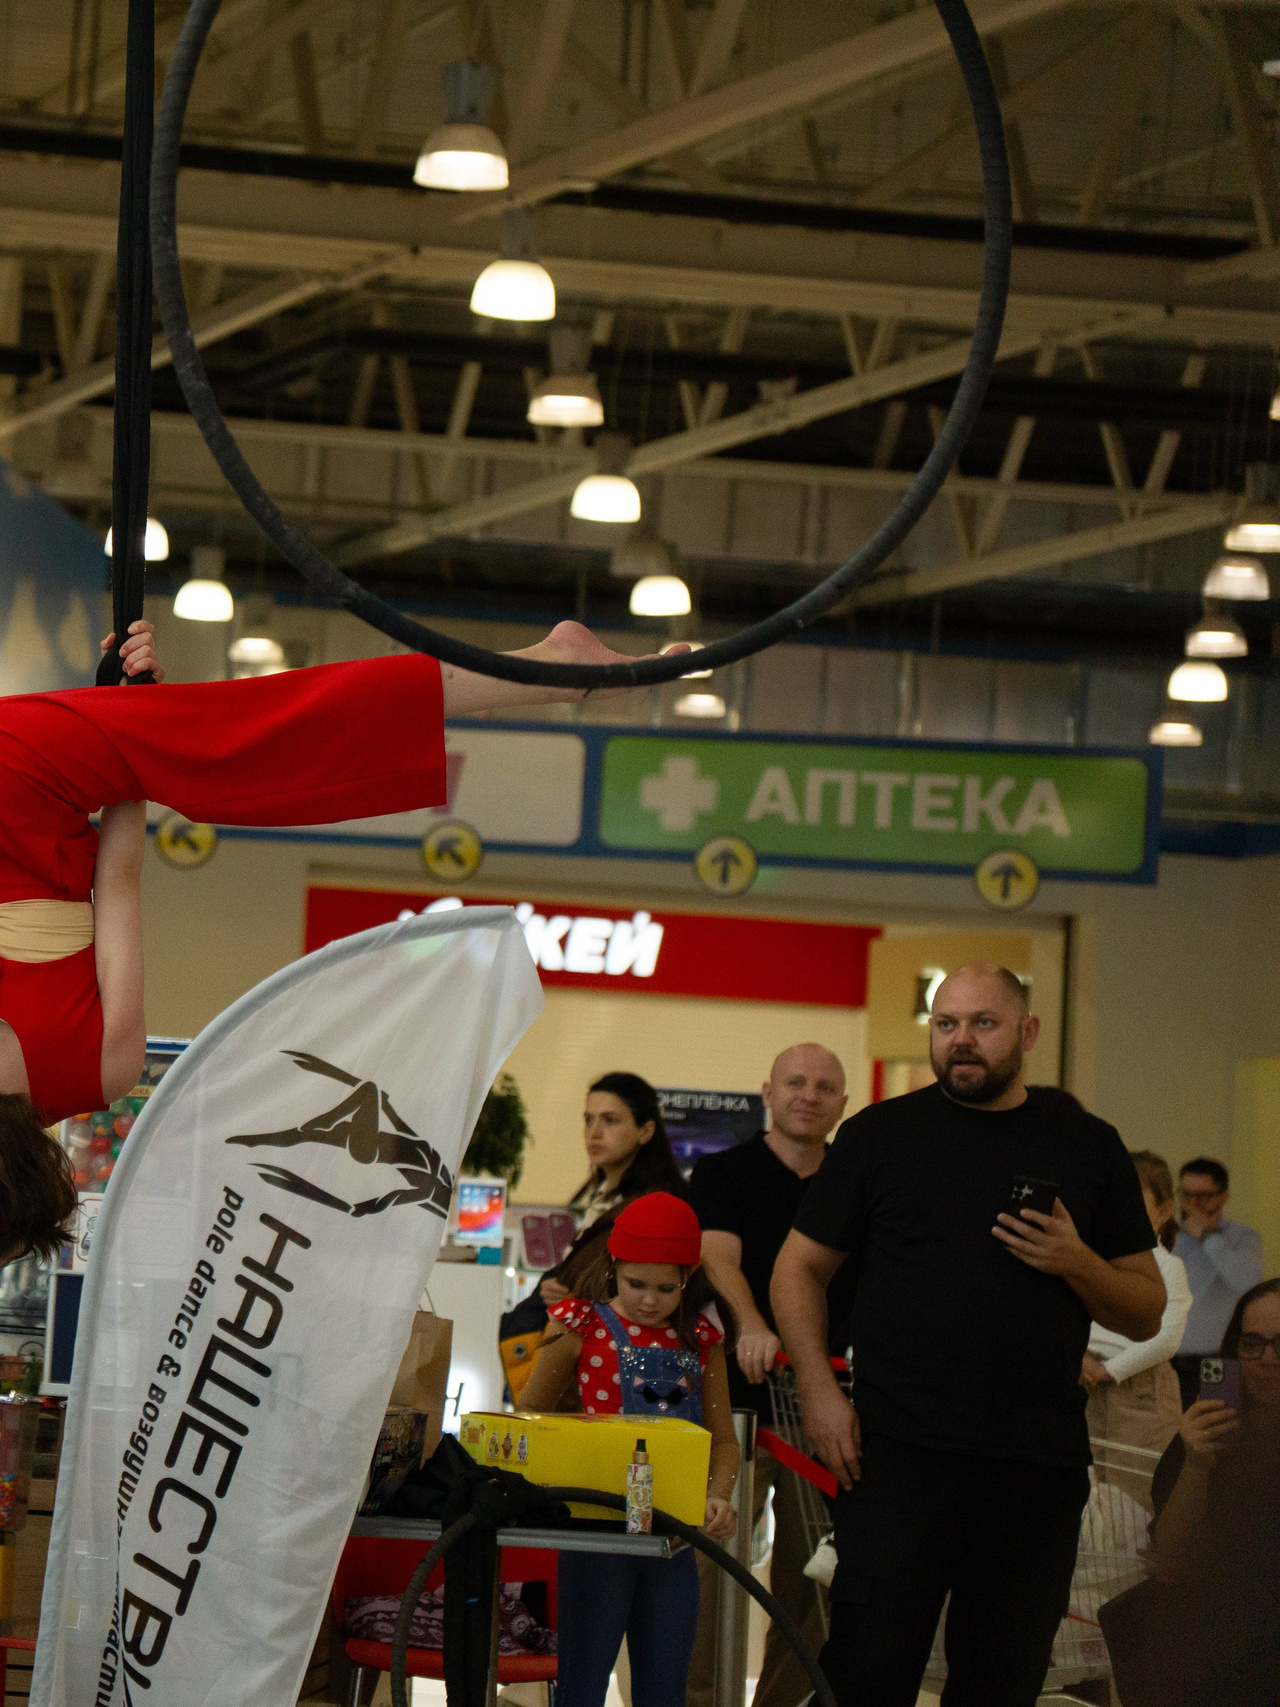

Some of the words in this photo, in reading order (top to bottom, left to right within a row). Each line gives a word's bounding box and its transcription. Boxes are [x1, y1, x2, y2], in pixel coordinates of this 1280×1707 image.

[745, 765, 1072, 838] АПТЕКА
[205, 1185, 245, 1255] pole
[168, 1259, 217, 1350] dance
[156, 1353, 182, 1378] &
[121, 1211, 312, 1704] НАШЕСТВ
